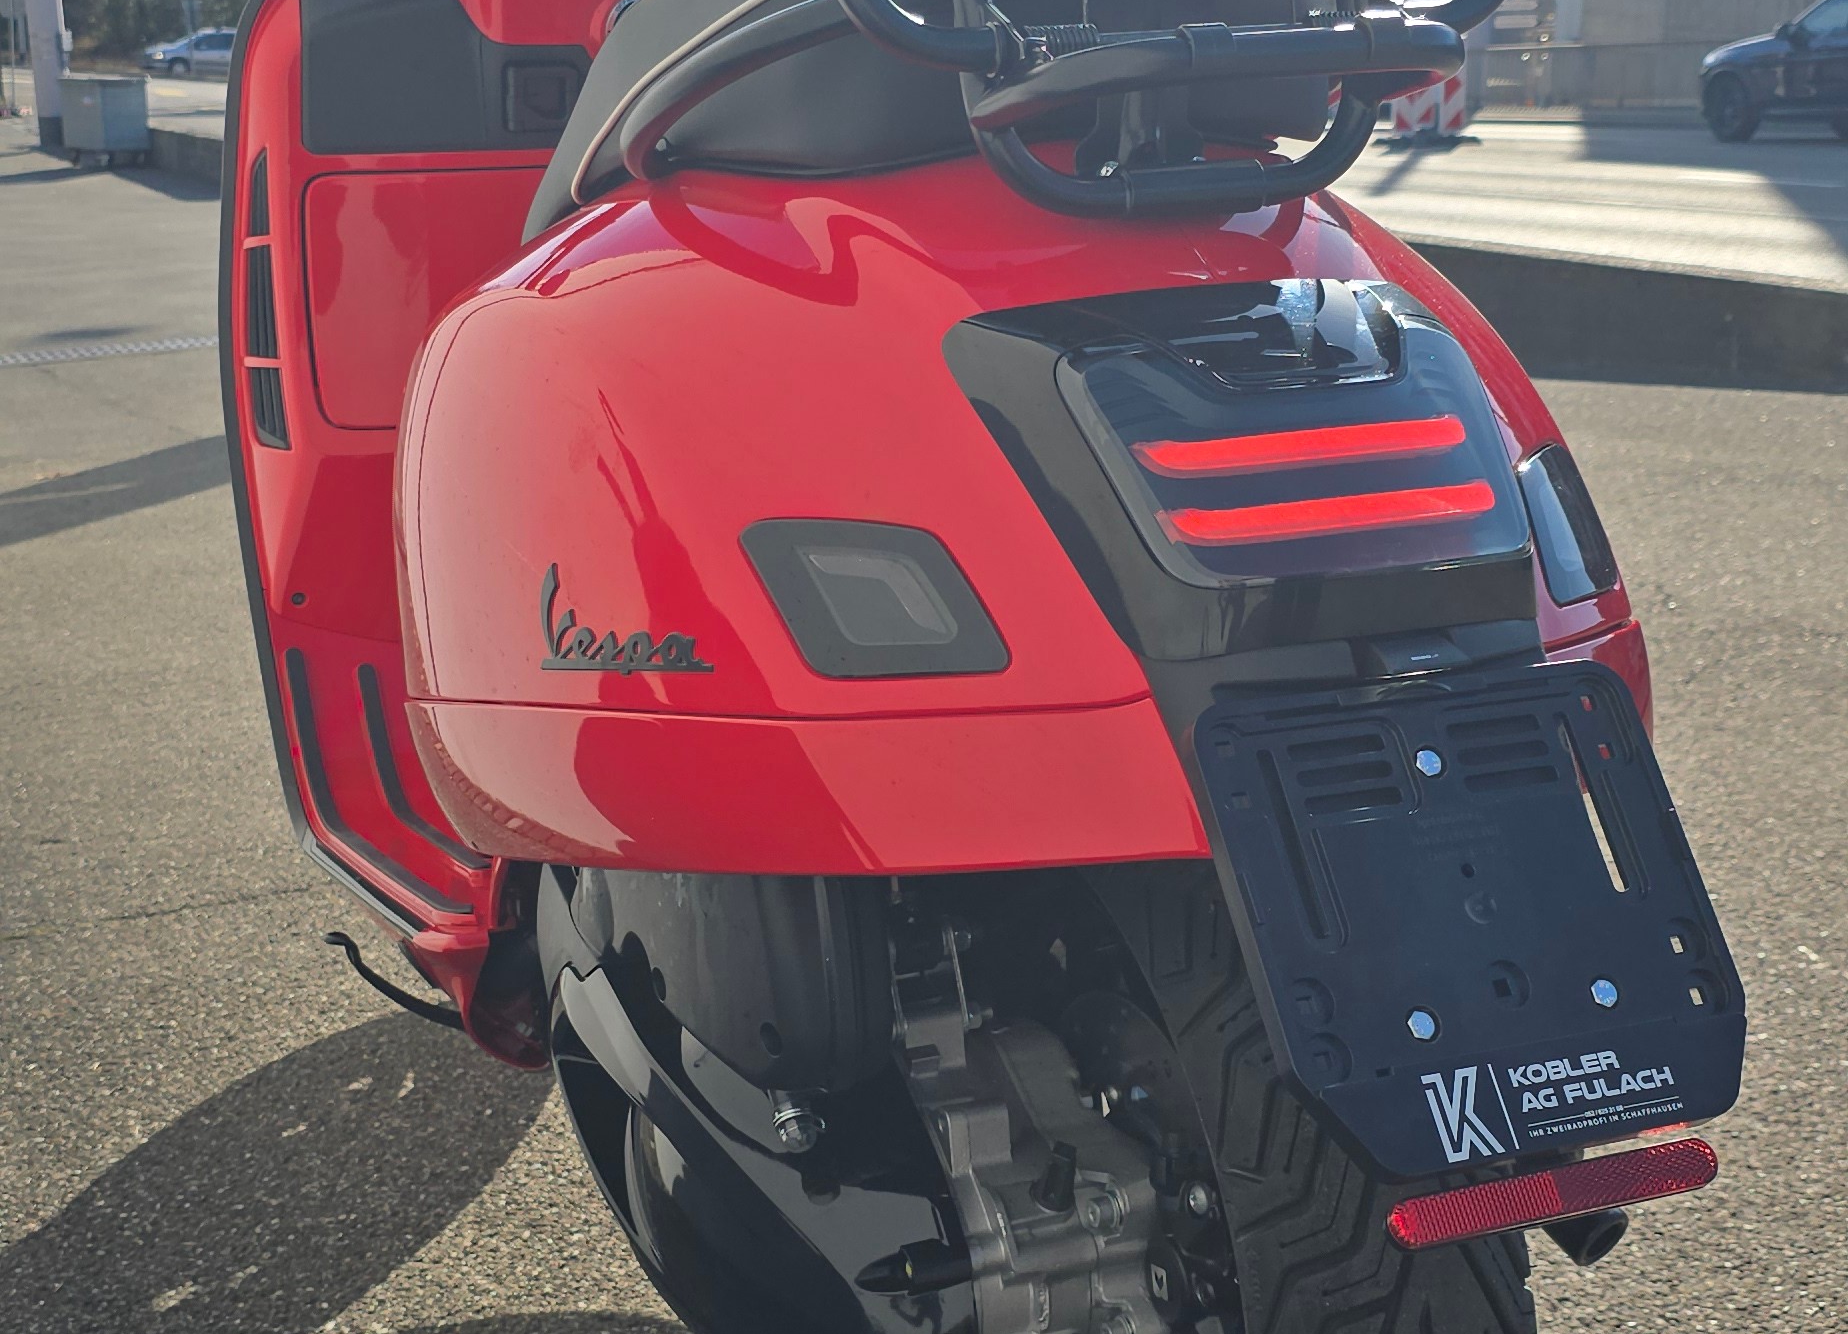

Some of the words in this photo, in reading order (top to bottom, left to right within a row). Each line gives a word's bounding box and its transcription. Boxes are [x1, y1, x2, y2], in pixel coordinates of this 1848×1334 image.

[540, 563, 714, 675] Vespa
[1508, 1050, 1620, 1087] KOBLER
[1522, 1087, 1559, 1113] AG
[1562, 1066, 1675, 1104] FULACH
[1528, 1128, 1545, 1138] IHR
[1545, 1117, 1608, 1135] ZWEIRADPROFI
[1608, 1114, 1619, 1123] IN
[1620, 1101, 1684, 1121] SCHAFFHAUSEN
